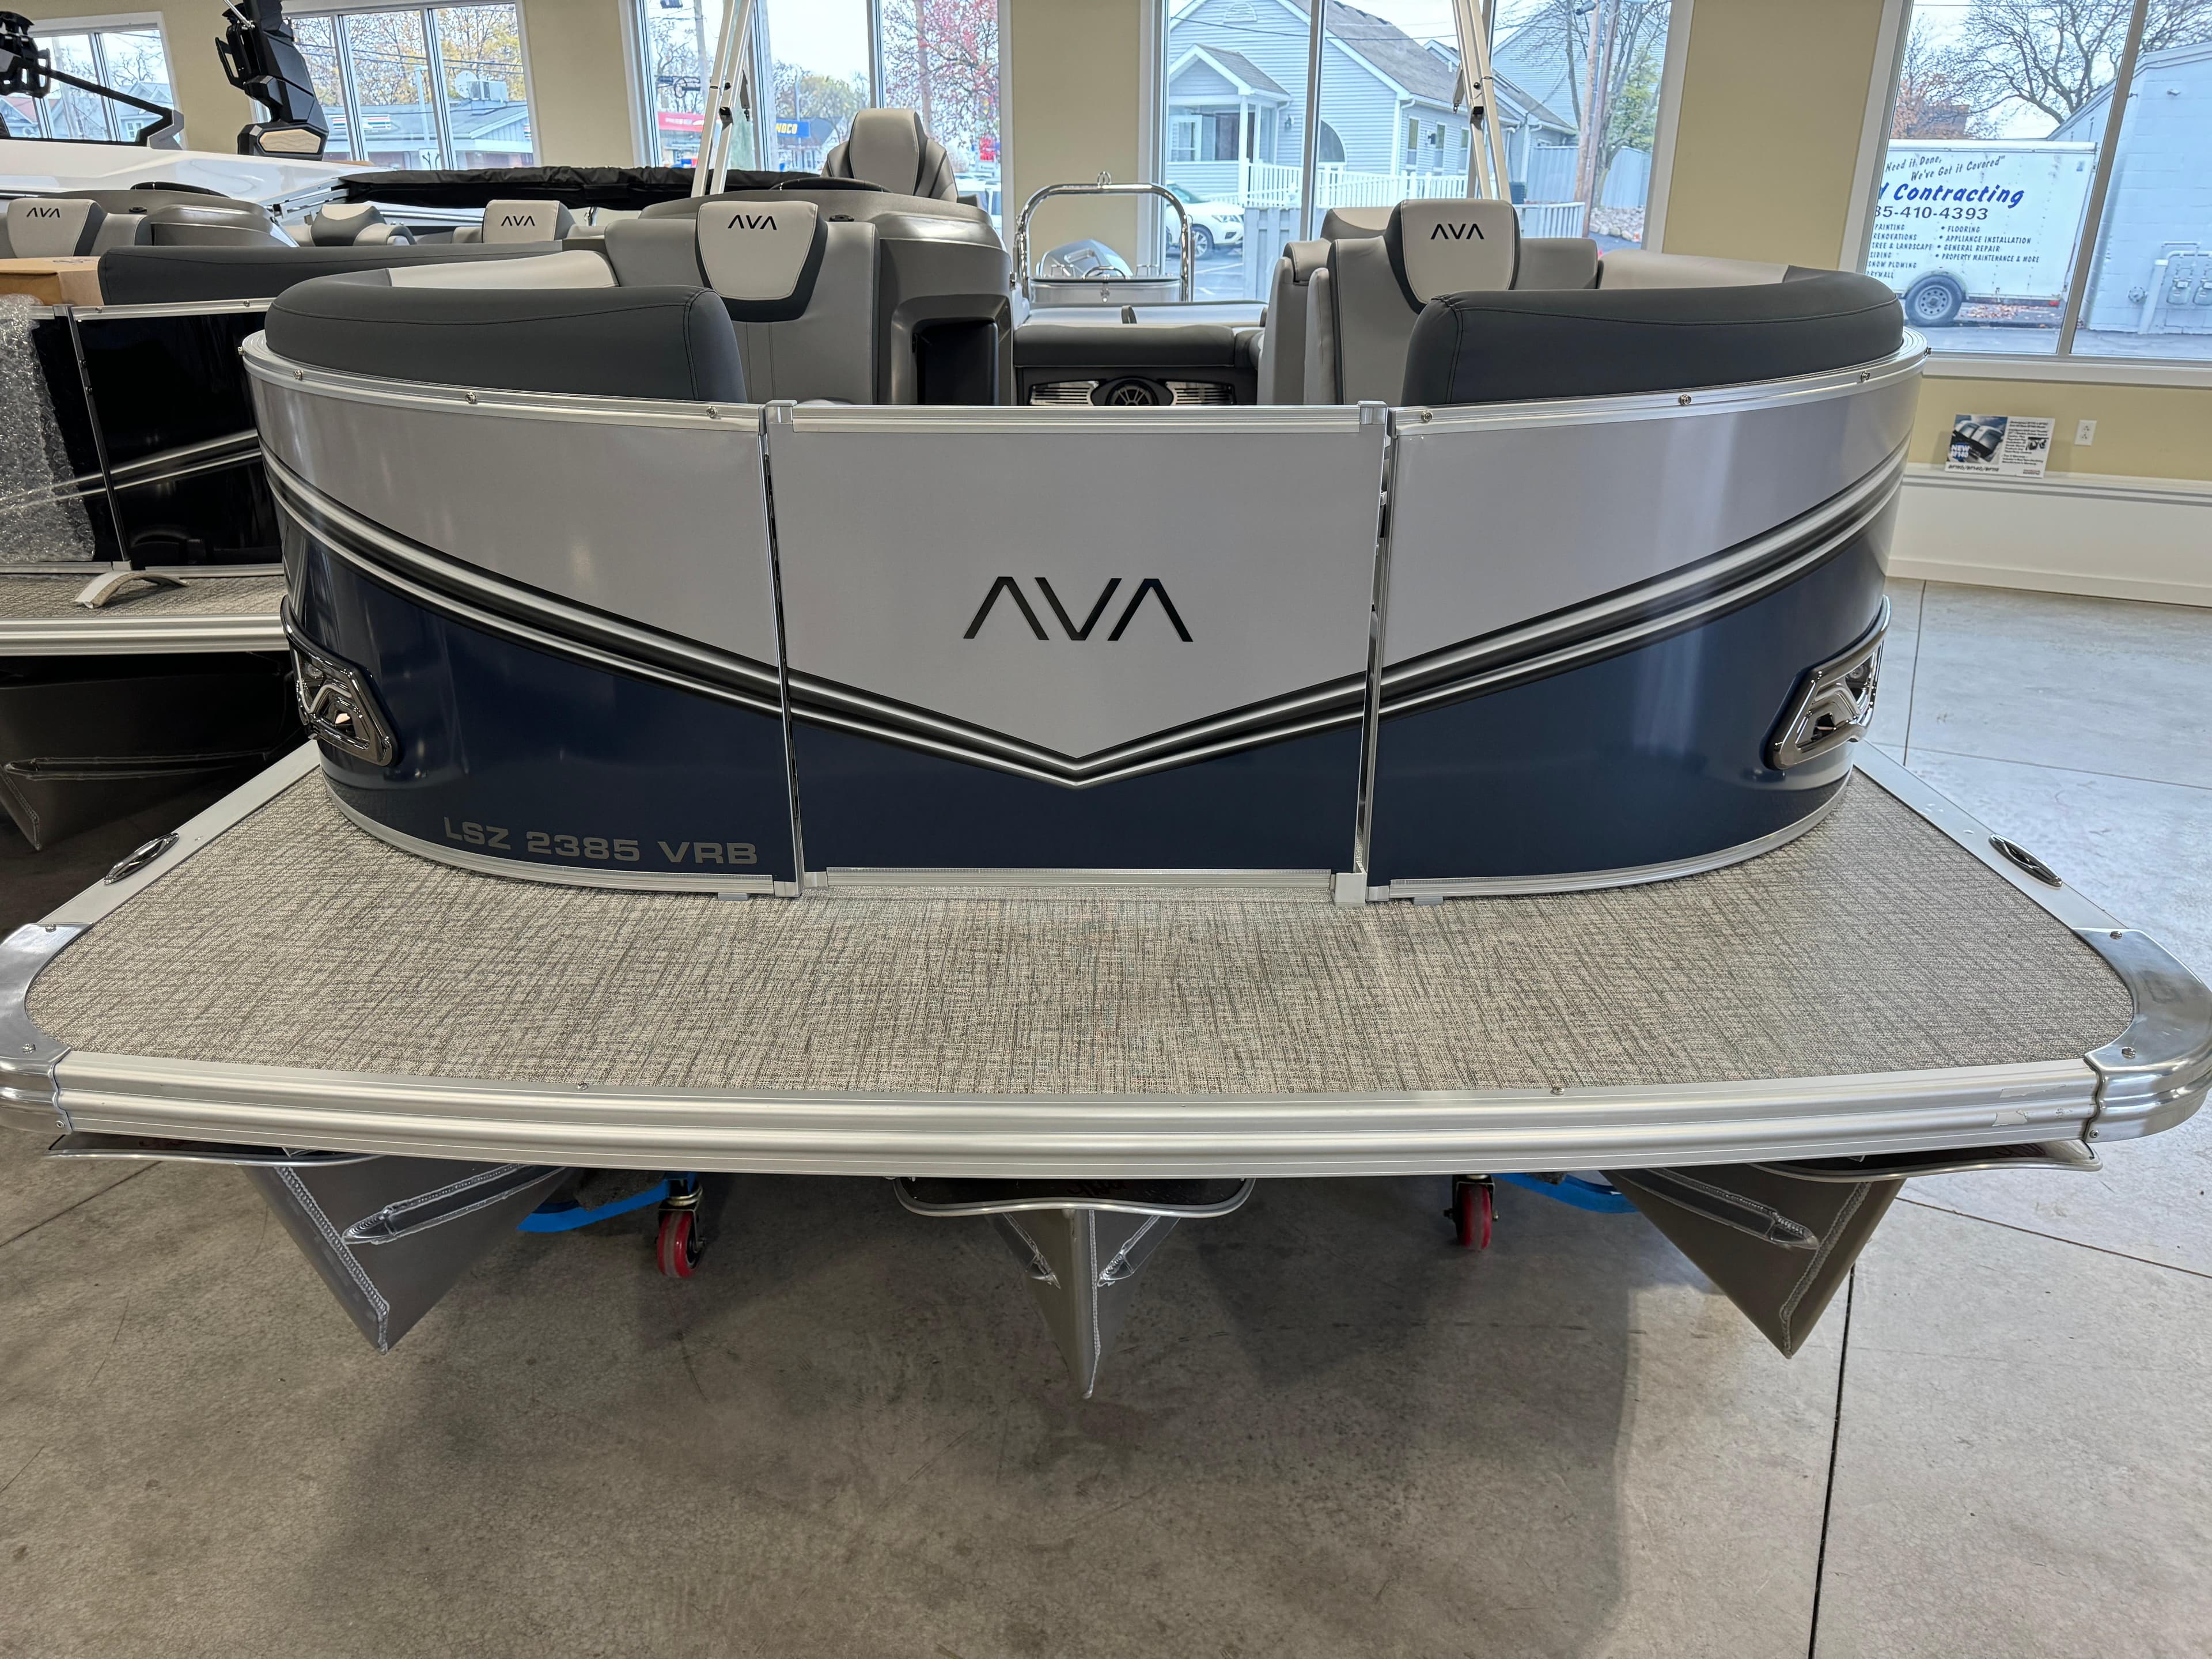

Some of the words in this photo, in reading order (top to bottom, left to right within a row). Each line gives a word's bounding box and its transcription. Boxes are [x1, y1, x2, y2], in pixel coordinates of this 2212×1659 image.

[1885, 159, 1907, 173] Need
[1911, 169, 1934, 181] We've
[1938, 166, 1952, 176] Got
[1956, 164, 1963, 173] it
[1893, 183, 2024, 209] Contracting
[26, 207, 60, 218] AVA
[501, 215, 535, 226] AVA
[728, 214, 777, 230] AVA
[1430, 224, 1484, 240] AVA
[1945, 235, 1982, 243] APPLIANCE
[1896, 243, 1933, 251] LANDSCAPE
[963, 576, 1194, 642] AVA
[444, 817, 511, 850] LSZ
[527, 831, 640, 862] 2385
[657, 841, 758, 865] VRB
